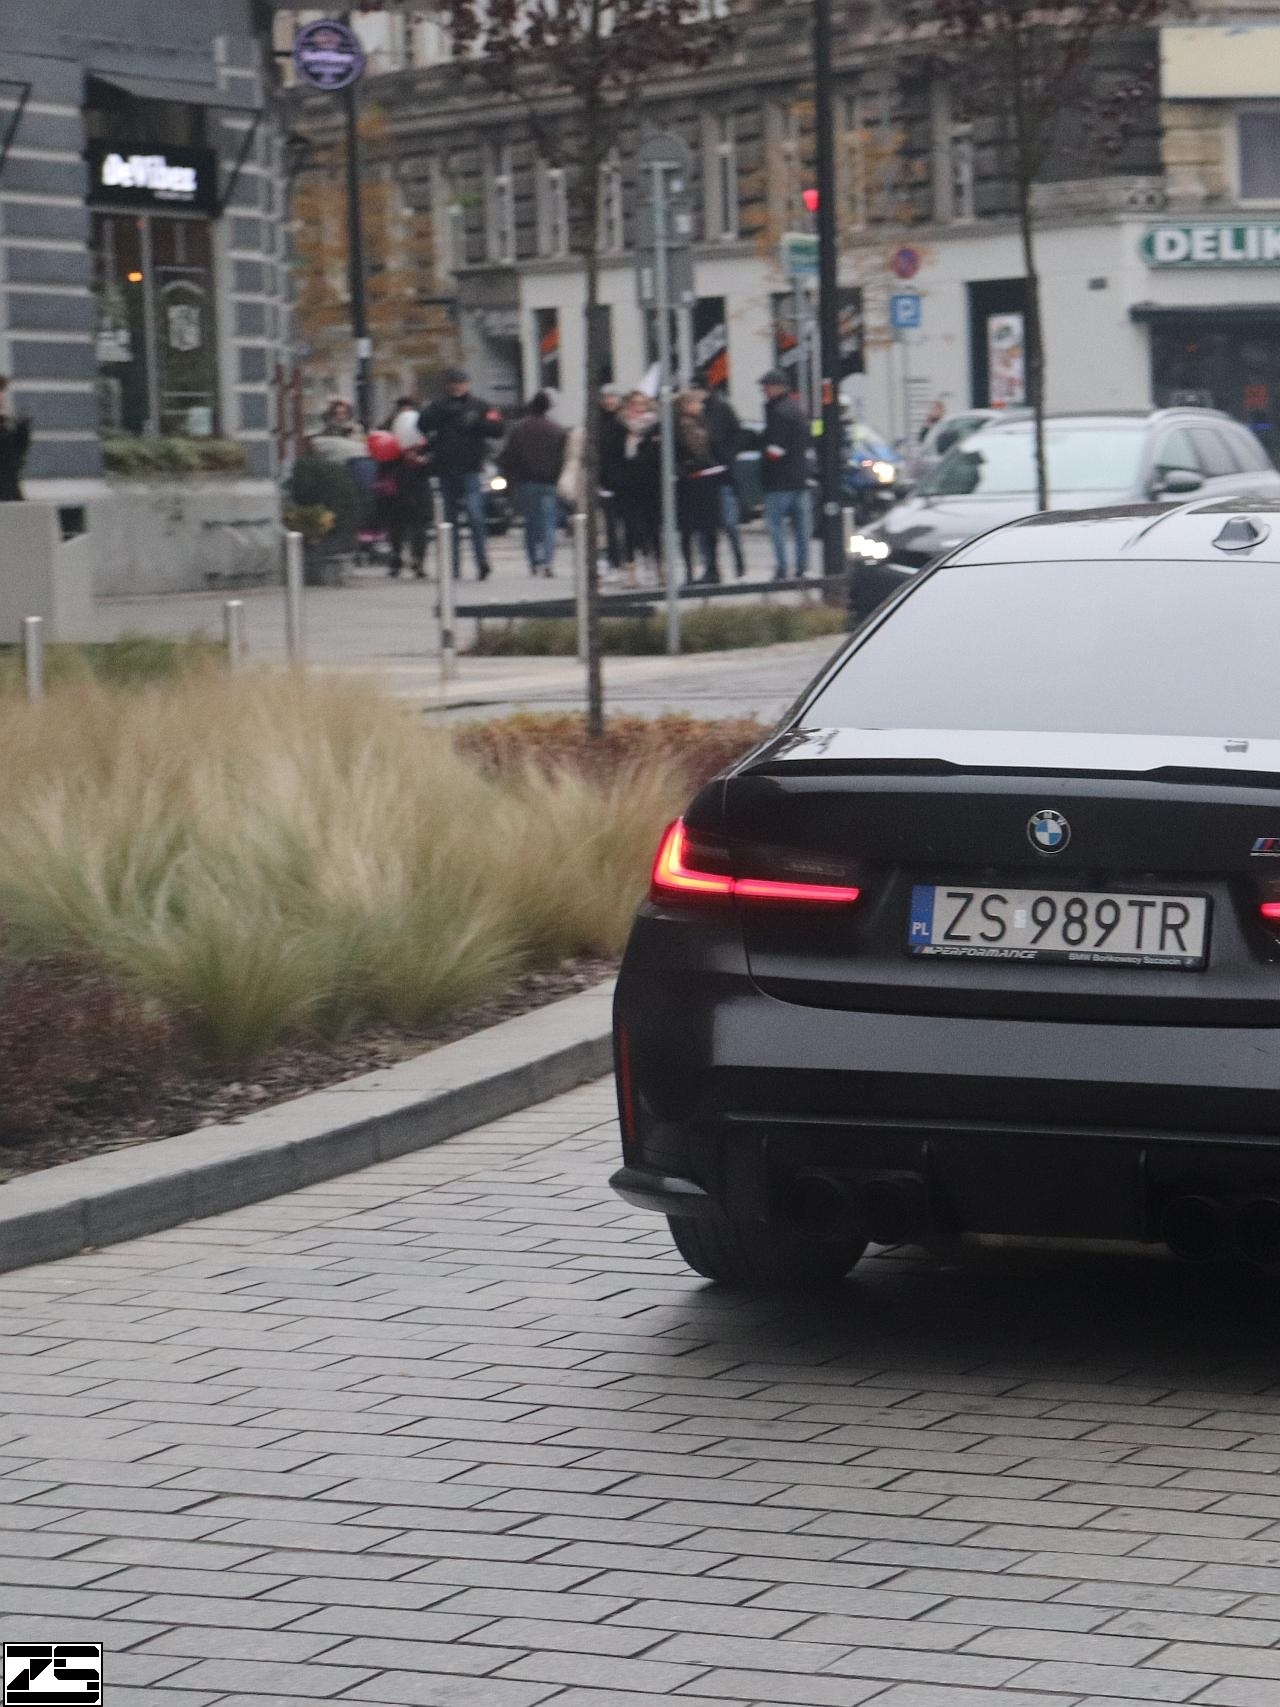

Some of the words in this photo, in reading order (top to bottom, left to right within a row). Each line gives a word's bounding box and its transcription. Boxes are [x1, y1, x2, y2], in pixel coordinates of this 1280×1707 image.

[911, 921, 930, 936] PL
[943, 891, 1009, 942] ZS
[1030, 895, 1191, 952] 989TR
